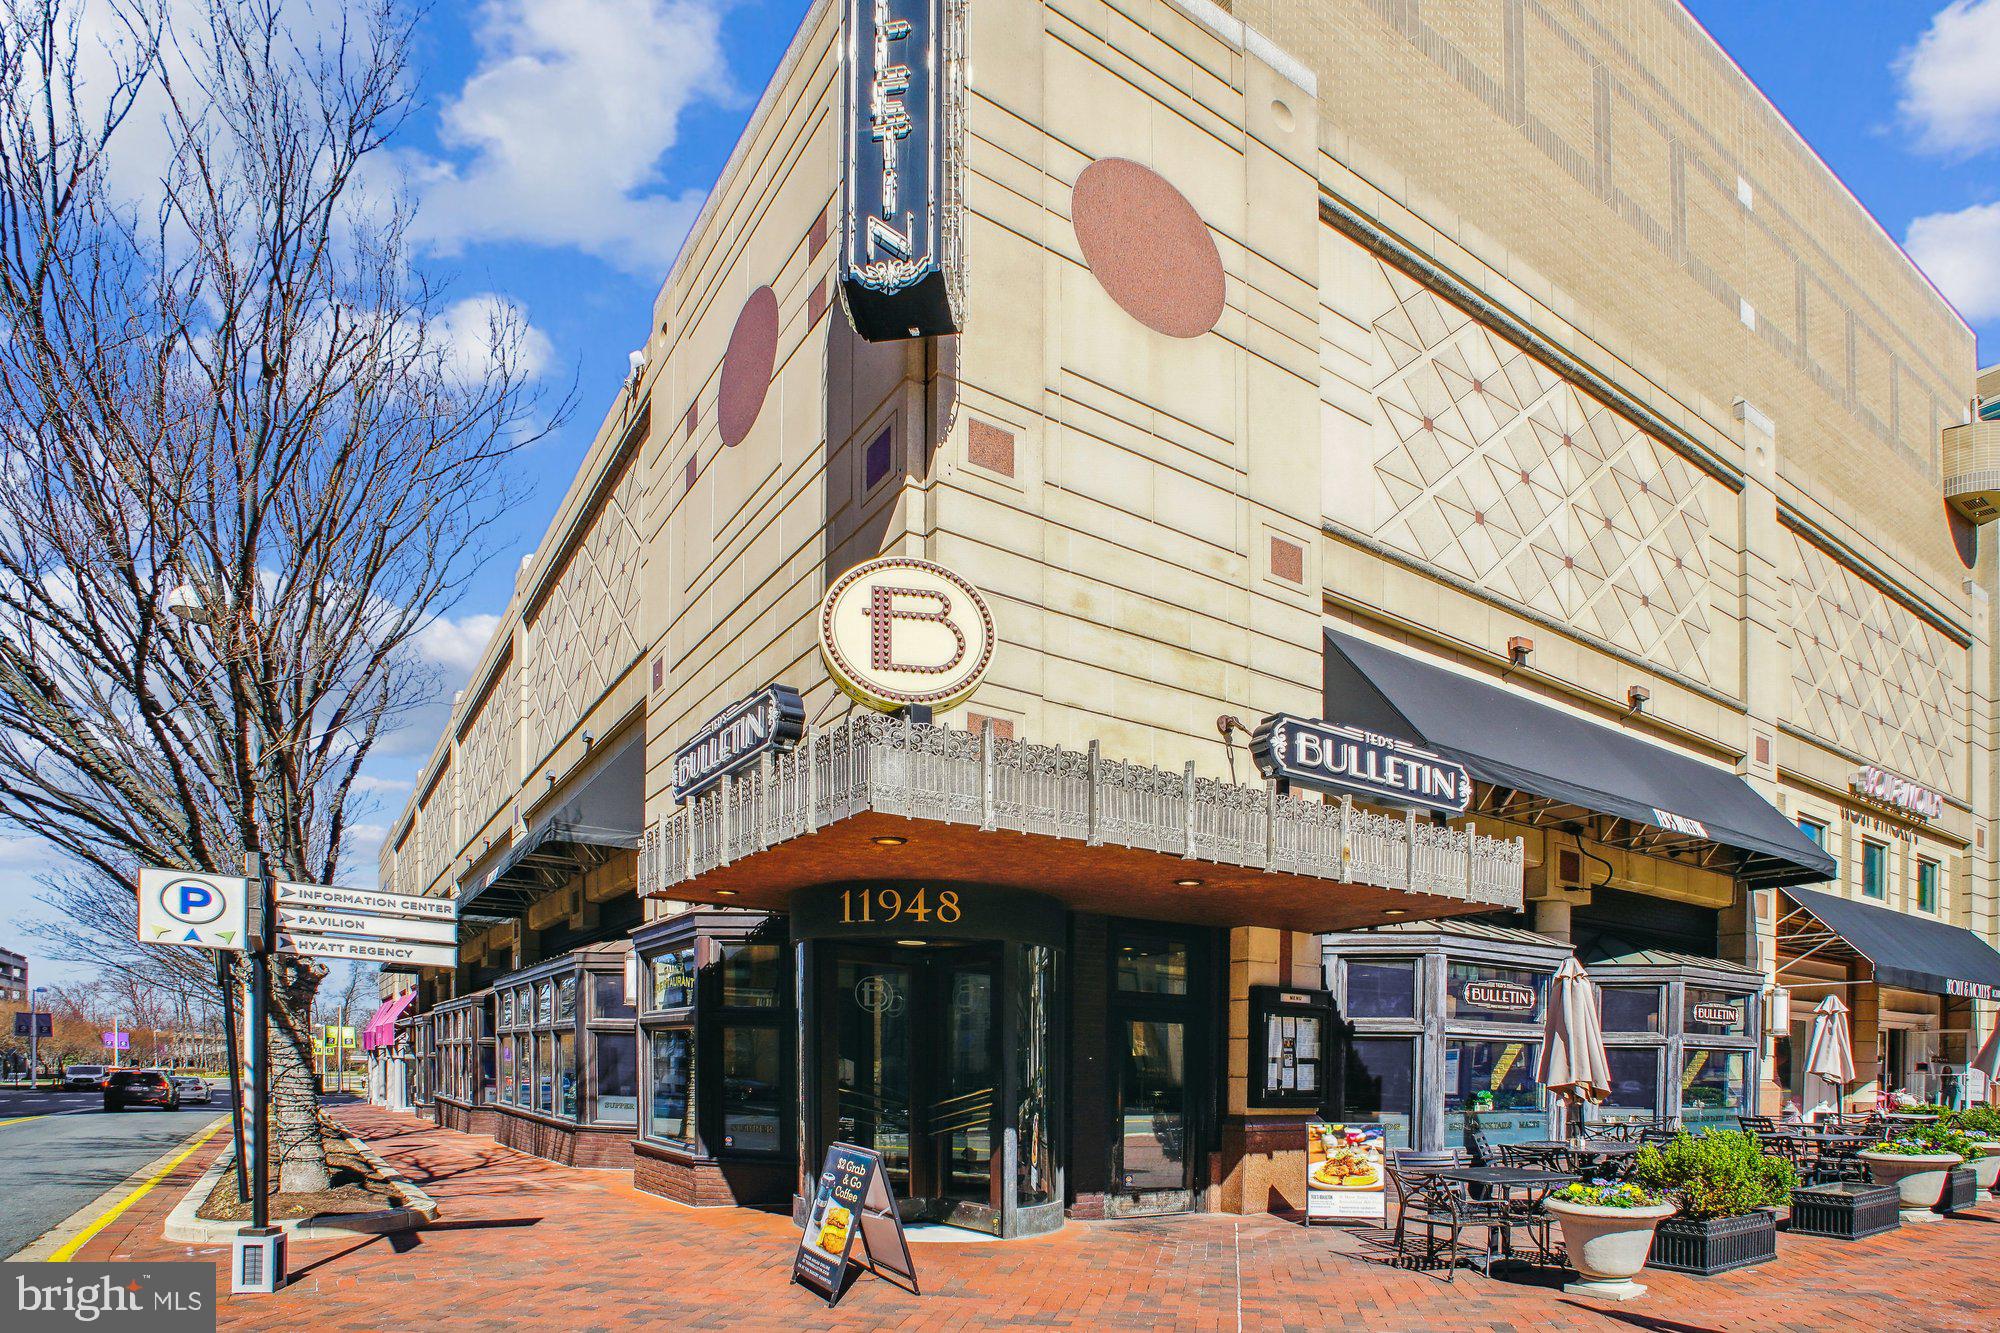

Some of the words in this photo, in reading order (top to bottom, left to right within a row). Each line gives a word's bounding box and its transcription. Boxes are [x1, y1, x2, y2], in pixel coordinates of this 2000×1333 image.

[861, 584, 967, 674] B
[678, 705, 768, 788] BULLETIN
[1363, 731, 1395, 750] TED'S
[1295, 731, 1456, 801] BULLETIN
[181, 885, 213, 915] P
[299, 889, 396, 909] INFORMATION
[401, 901, 453, 914] CENTER
[839, 887, 961, 923] 11948
[299, 914, 365, 930] PAVILION
[299, 940, 345, 954] HYATT
[350, 944, 414, 958] REGENCY
[1471, 987, 1530, 1005] BULLETIN
[1698, 1007, 1735, 1021] BULLETIN
[604, 1101, 636, 1110] SUPPER
[837, 1157, 847, 1170] $2
[846, 1160, 866, 1176] Grab
[842, 1173, 849, 1185] &
[850, 1176, 862, 1189] Go
[835, 1185, 858, 1203] Coffee
